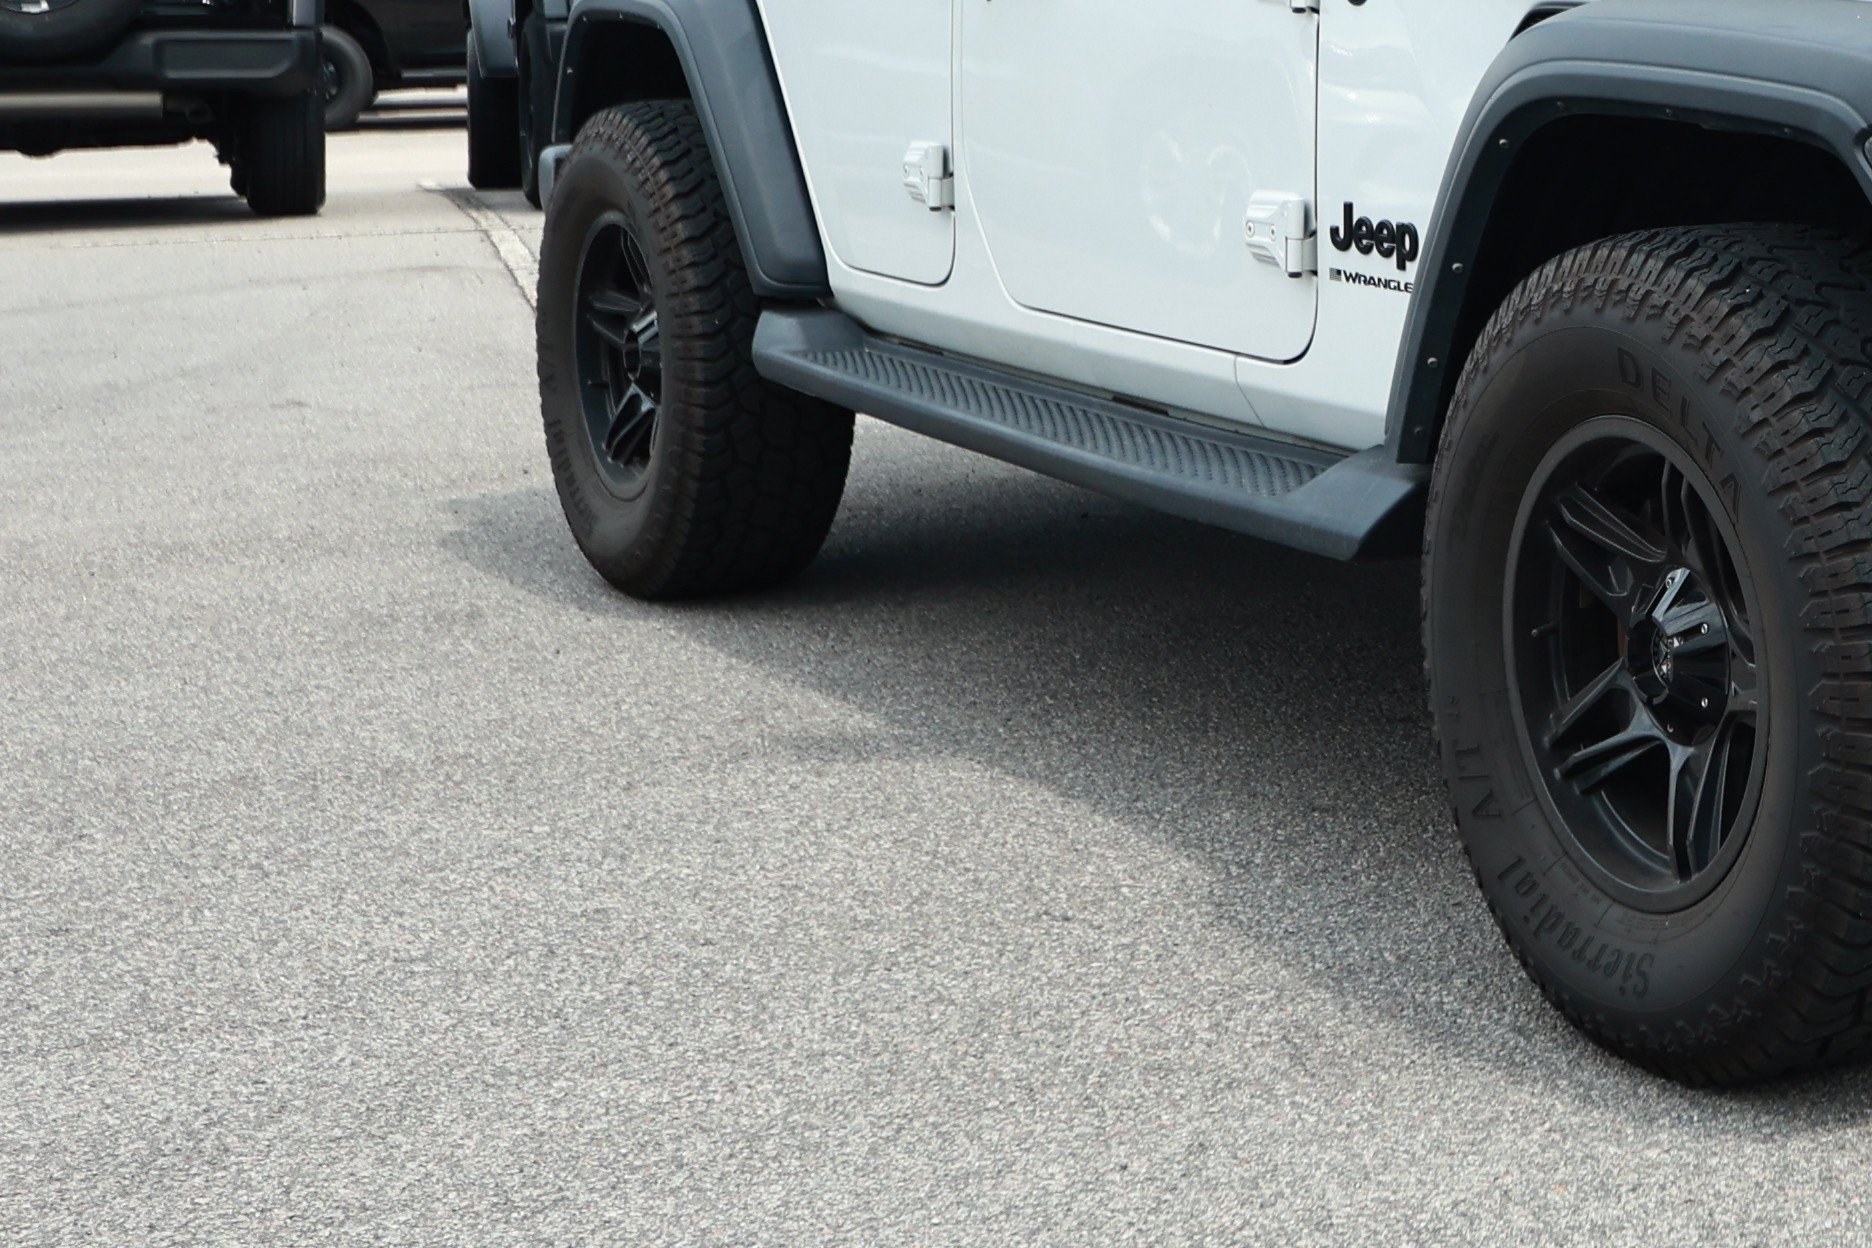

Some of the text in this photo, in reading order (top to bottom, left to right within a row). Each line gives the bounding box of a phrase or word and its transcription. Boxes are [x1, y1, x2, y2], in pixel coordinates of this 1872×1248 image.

[1329, 201, 1419, 271] Jeep
[1343, 269, 1414, 293] WRANGLE
[1617, 346, 1741, 524] DELTA
[1496, 855, 1655, 1000] Sierradial
